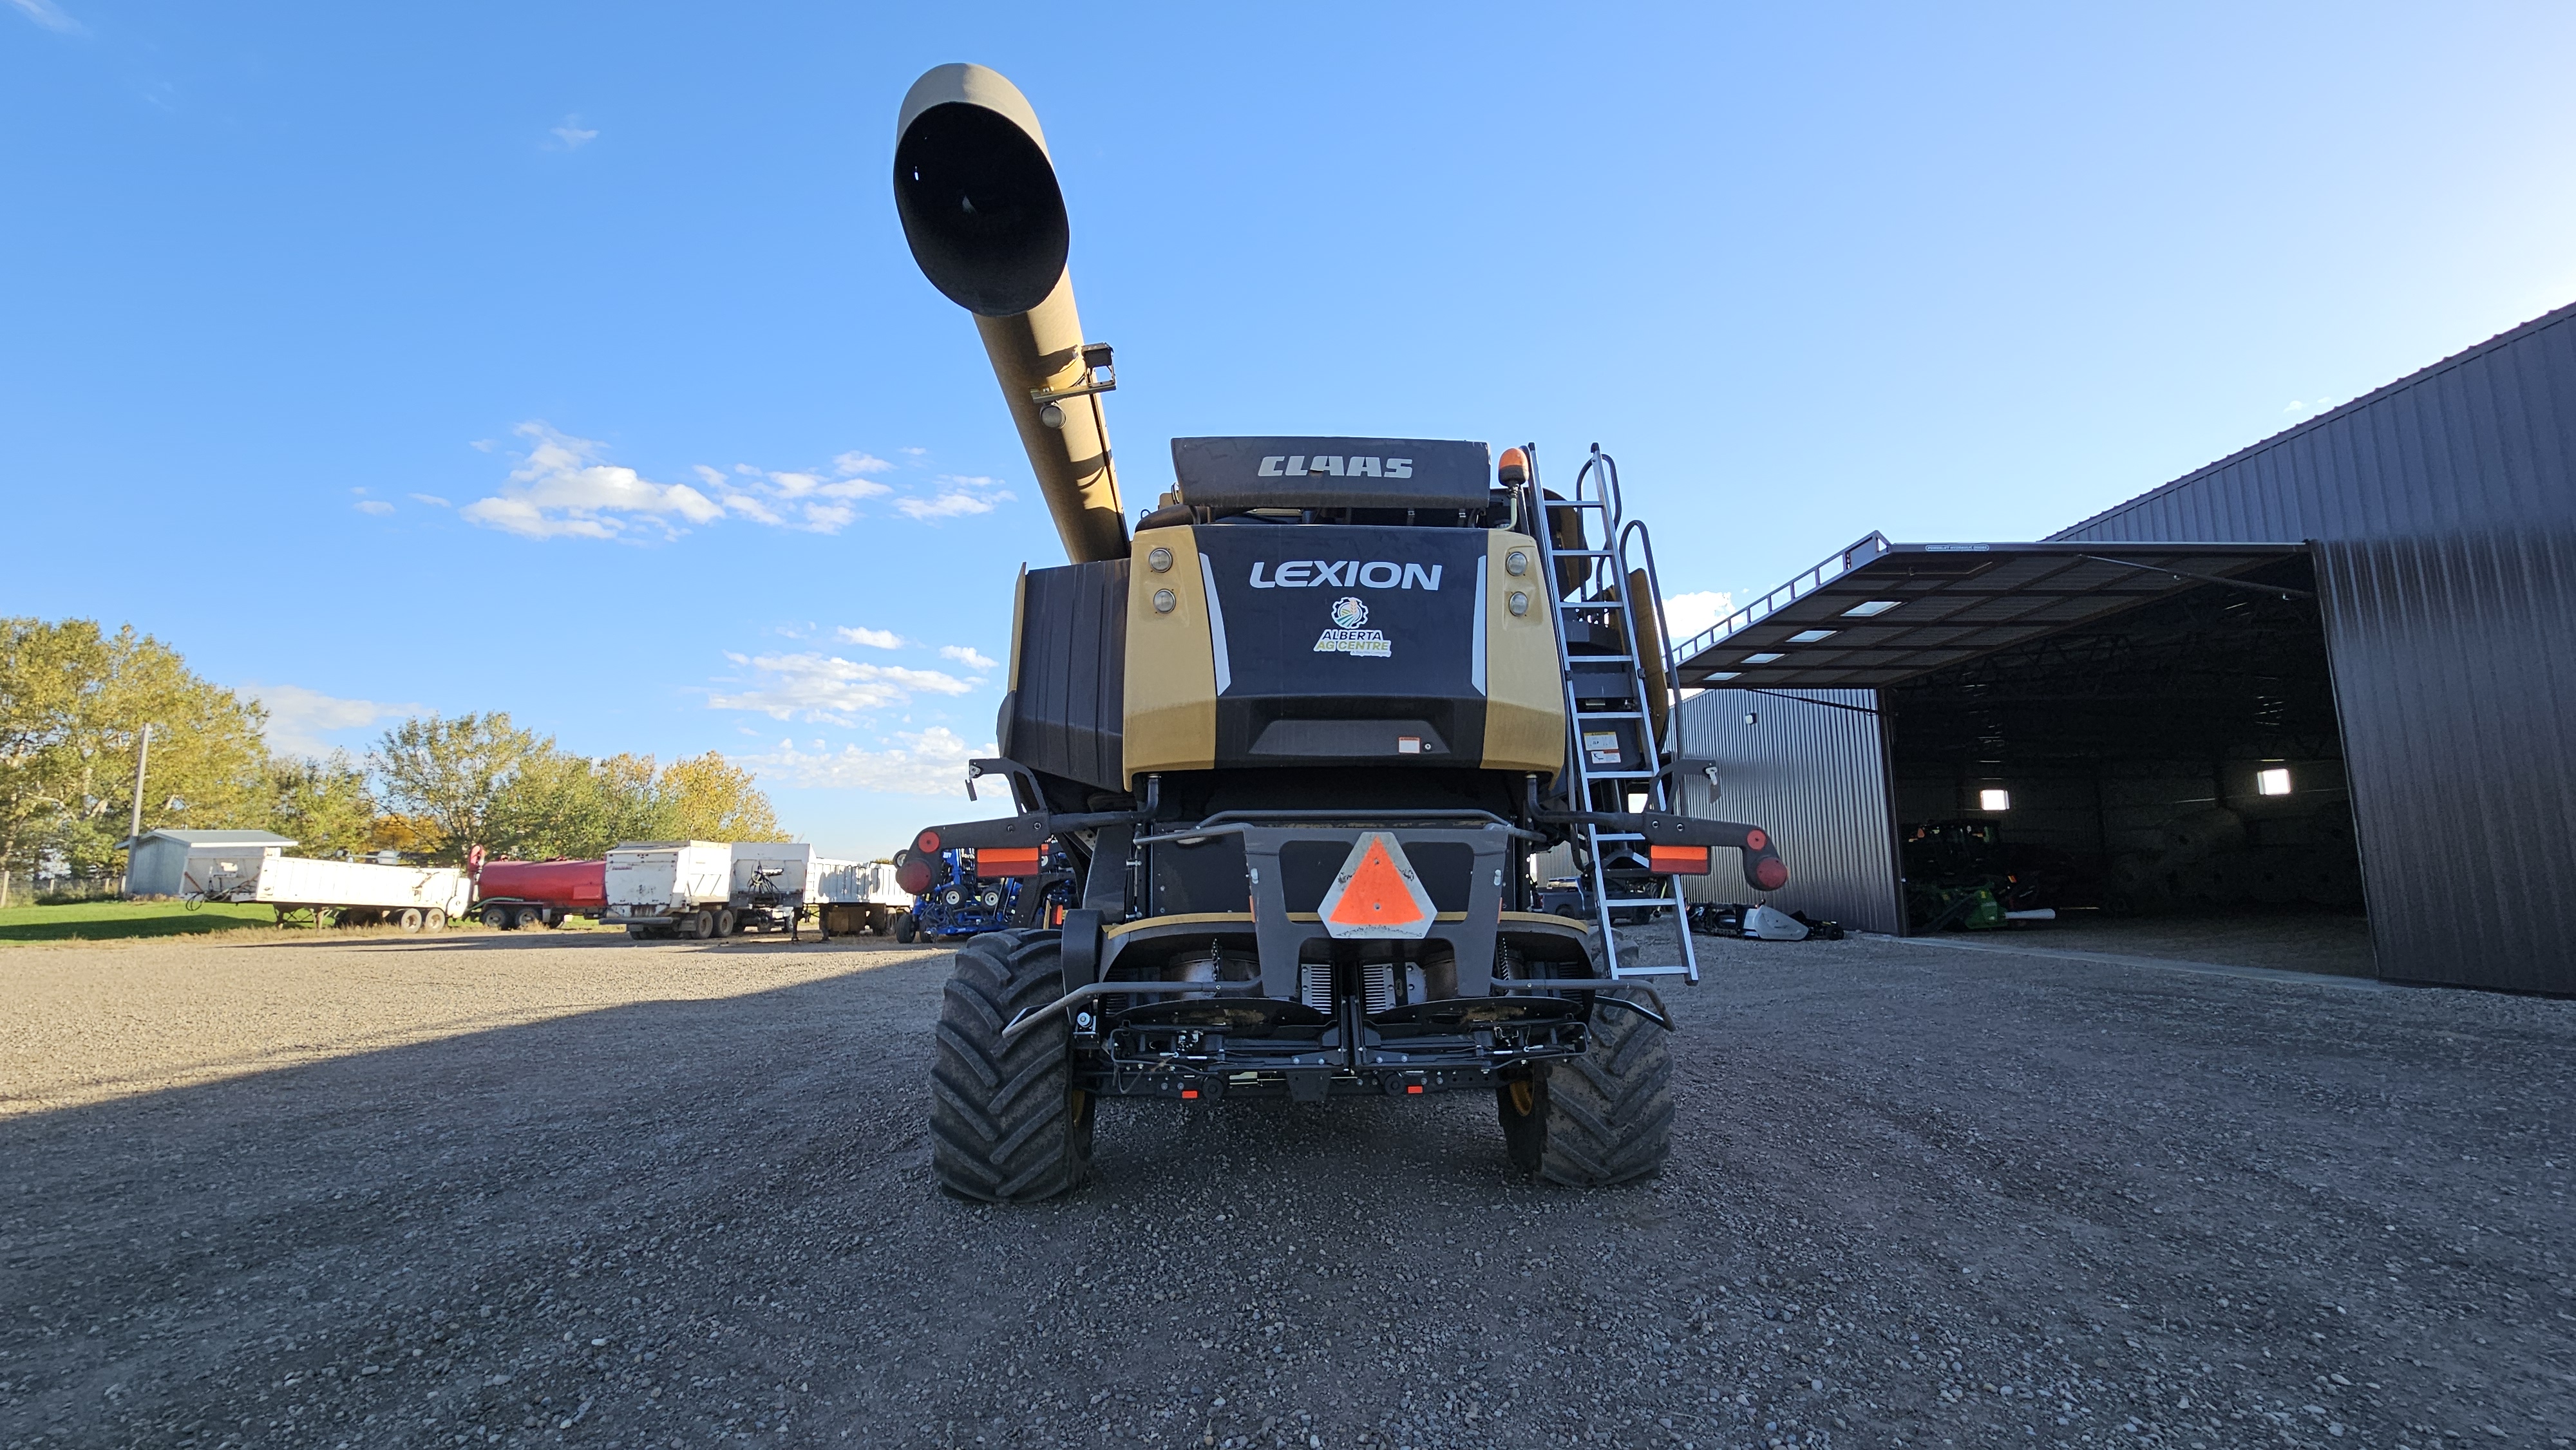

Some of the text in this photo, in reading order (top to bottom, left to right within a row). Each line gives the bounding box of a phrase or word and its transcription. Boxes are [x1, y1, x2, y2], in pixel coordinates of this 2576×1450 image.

[1258, 455, 1413, 478] CLAAS
[1249, 561, 1442, 590] LEXION
[1322, 631, 1381, 640] ALBERTA
[1316, 641, 1389, 650] AG CENTRE
